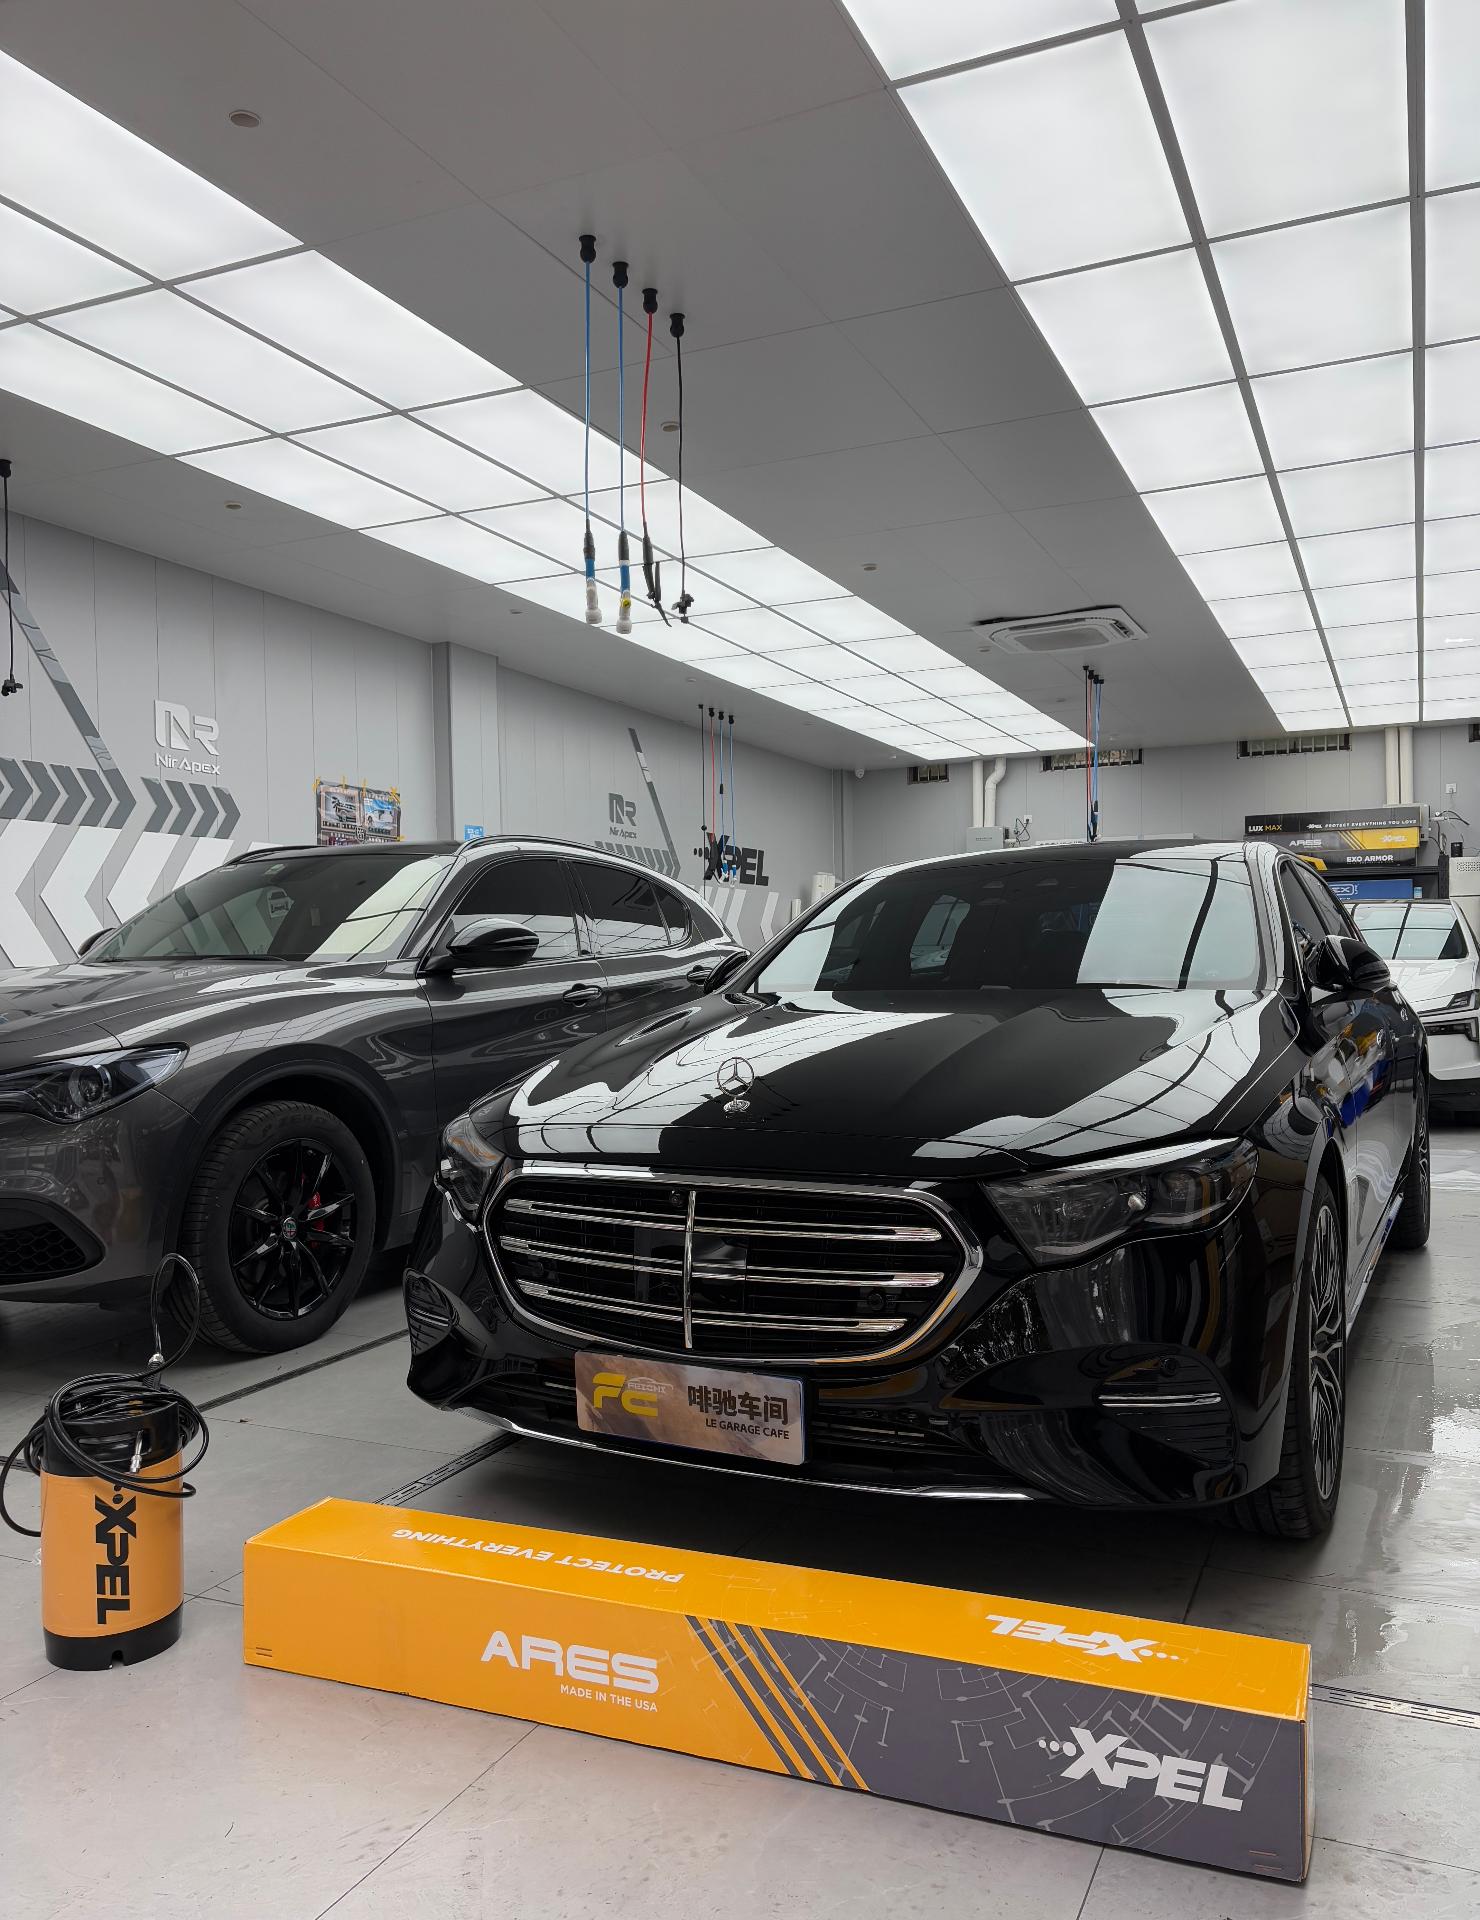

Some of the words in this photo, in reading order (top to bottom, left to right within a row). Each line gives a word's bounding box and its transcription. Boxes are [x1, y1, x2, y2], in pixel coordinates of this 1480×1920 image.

[155, 752, 221, 775] NirApex
[1248, 825, 1264, 833] LUX
[1264, 824, 1282, 832] MAX
[1351, 820, 1387, 828] EVERYTHING
[1289, 839, 1322, 847] ARES
[703, 832, 769, 887] XPEL
[1346, 855, 1363, 863] EXO
[1364, 854, 1394, 862] ARMOR
[687, 1385, 789, 1426] 啡驰车间
[705, 1418, 717, 1428] LE
[719, 1421, 761, 1435] GARAGE
[762, 1427, 790, 1440] CAFE
[94, 1495, 137, 1625] XPEL
[391, 1529, 554, 1562] EVERYTHING
[557, 1555, 685, 1583] PROTECT
[985, 1614, 1160, 1663] XPEL
[480, 1630, 660, 1694] ARES
[560, 1684, 592, 1699] MADE
[595, 1690, 607, 1702] IN
[610, 1693, 632, 1707] THE
[635, 1698, 658, 1713] USA
[1060, 1726, 1244, 1812] XPEL
